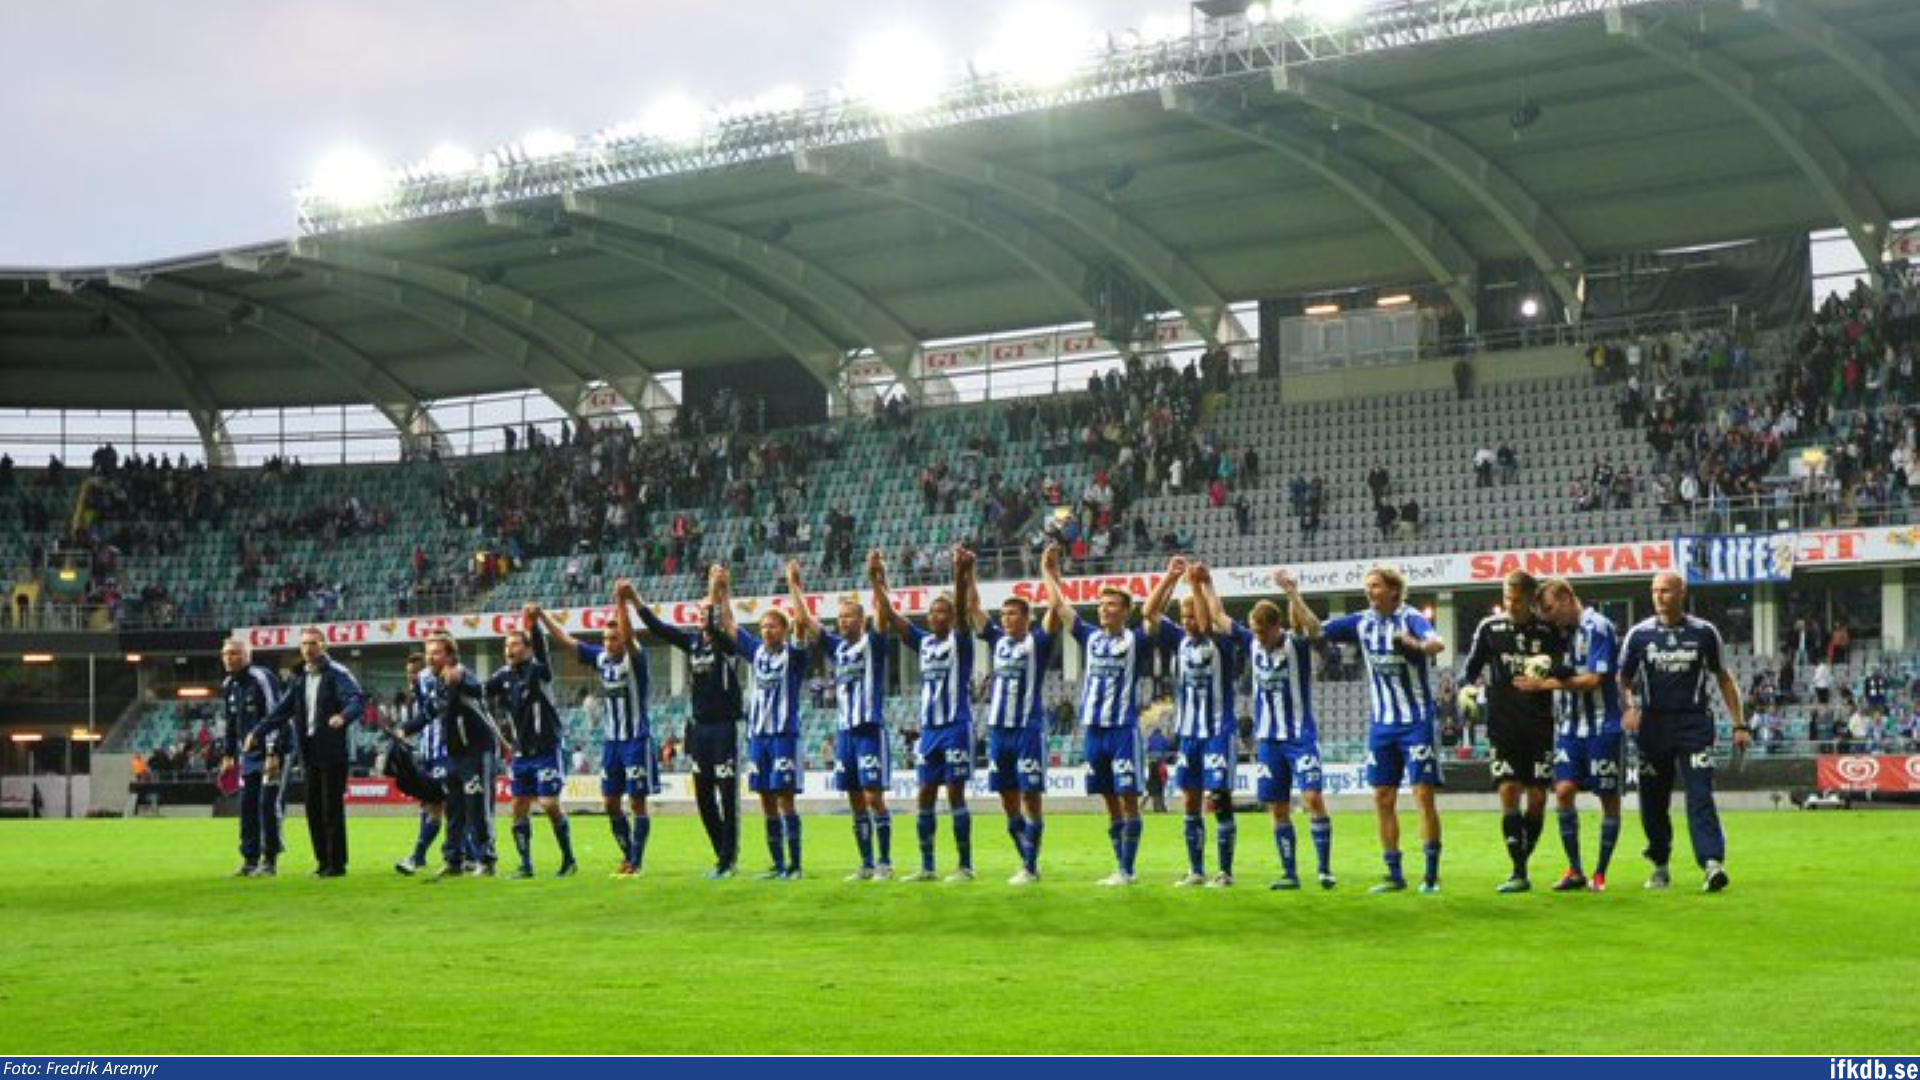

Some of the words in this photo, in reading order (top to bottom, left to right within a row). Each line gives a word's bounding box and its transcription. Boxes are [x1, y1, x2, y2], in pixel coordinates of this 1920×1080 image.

[1470, 544, 1671, 581] SANKTAN
[1711, 537, 1767, 581] LIFE
[250, 627, 290, 646] GT
[327, 623, 370, 643] GT
[1589, 758, 1618, 777] ICA
